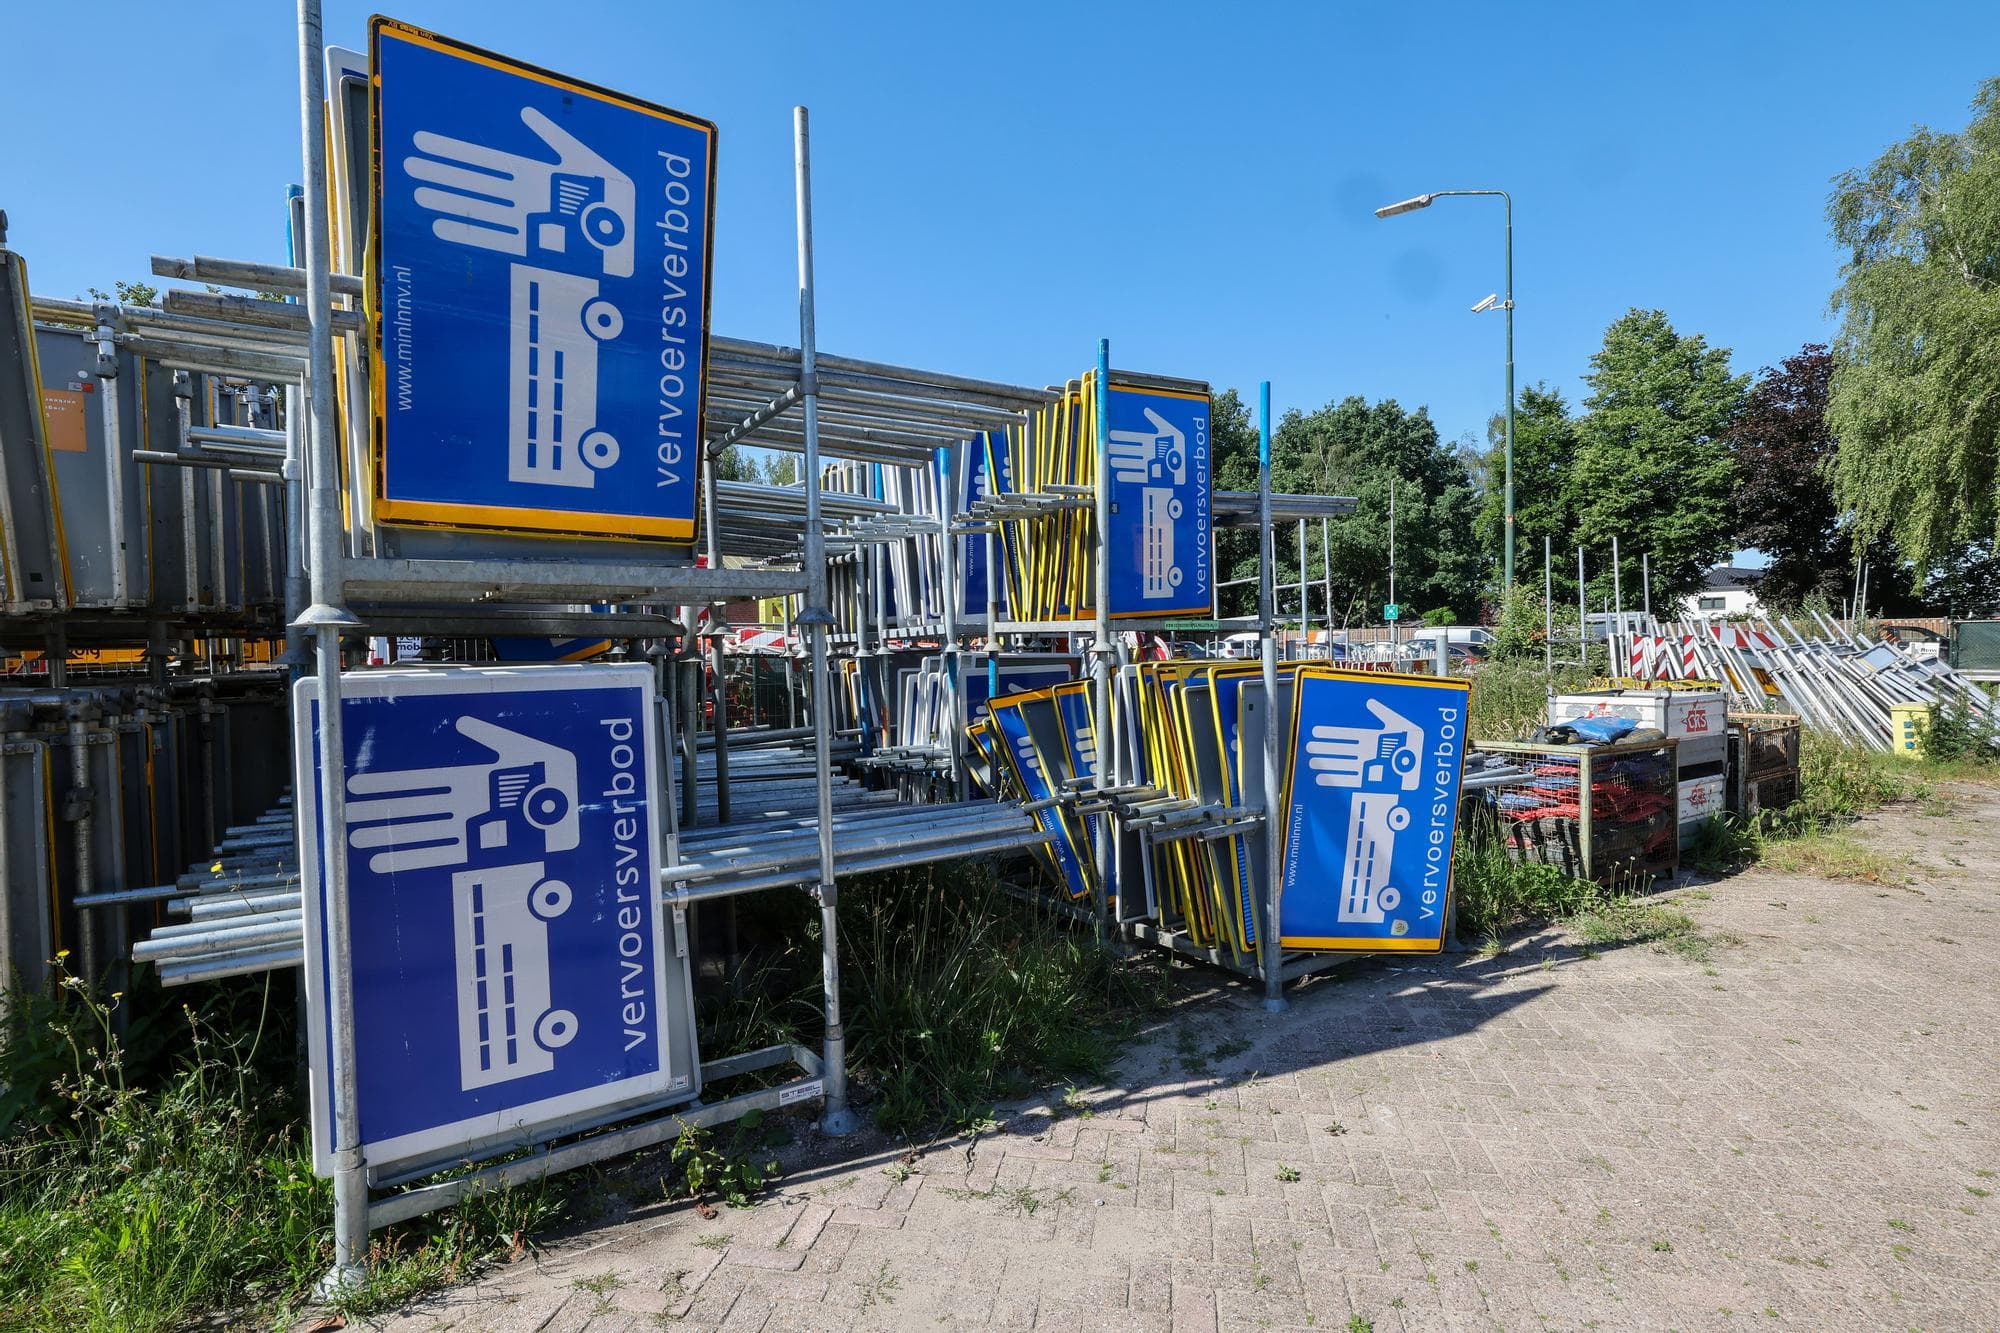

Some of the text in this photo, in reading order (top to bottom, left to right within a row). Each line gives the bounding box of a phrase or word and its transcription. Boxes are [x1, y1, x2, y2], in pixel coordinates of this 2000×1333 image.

[392, 265, 412, 411] www.minlnnv.nl
[656, 150, 691, 488] vervoersverbod
[1193, 417, 1207, 594] vervoersverbod
[1688, 714, 1707, 729] CRS
[600, 717, 646, 1052] vervoersverbod
[1287, 804, 1304, 887] www.minlnnv.nl
[1419, 707, 1458, 920] vervoersverbod
